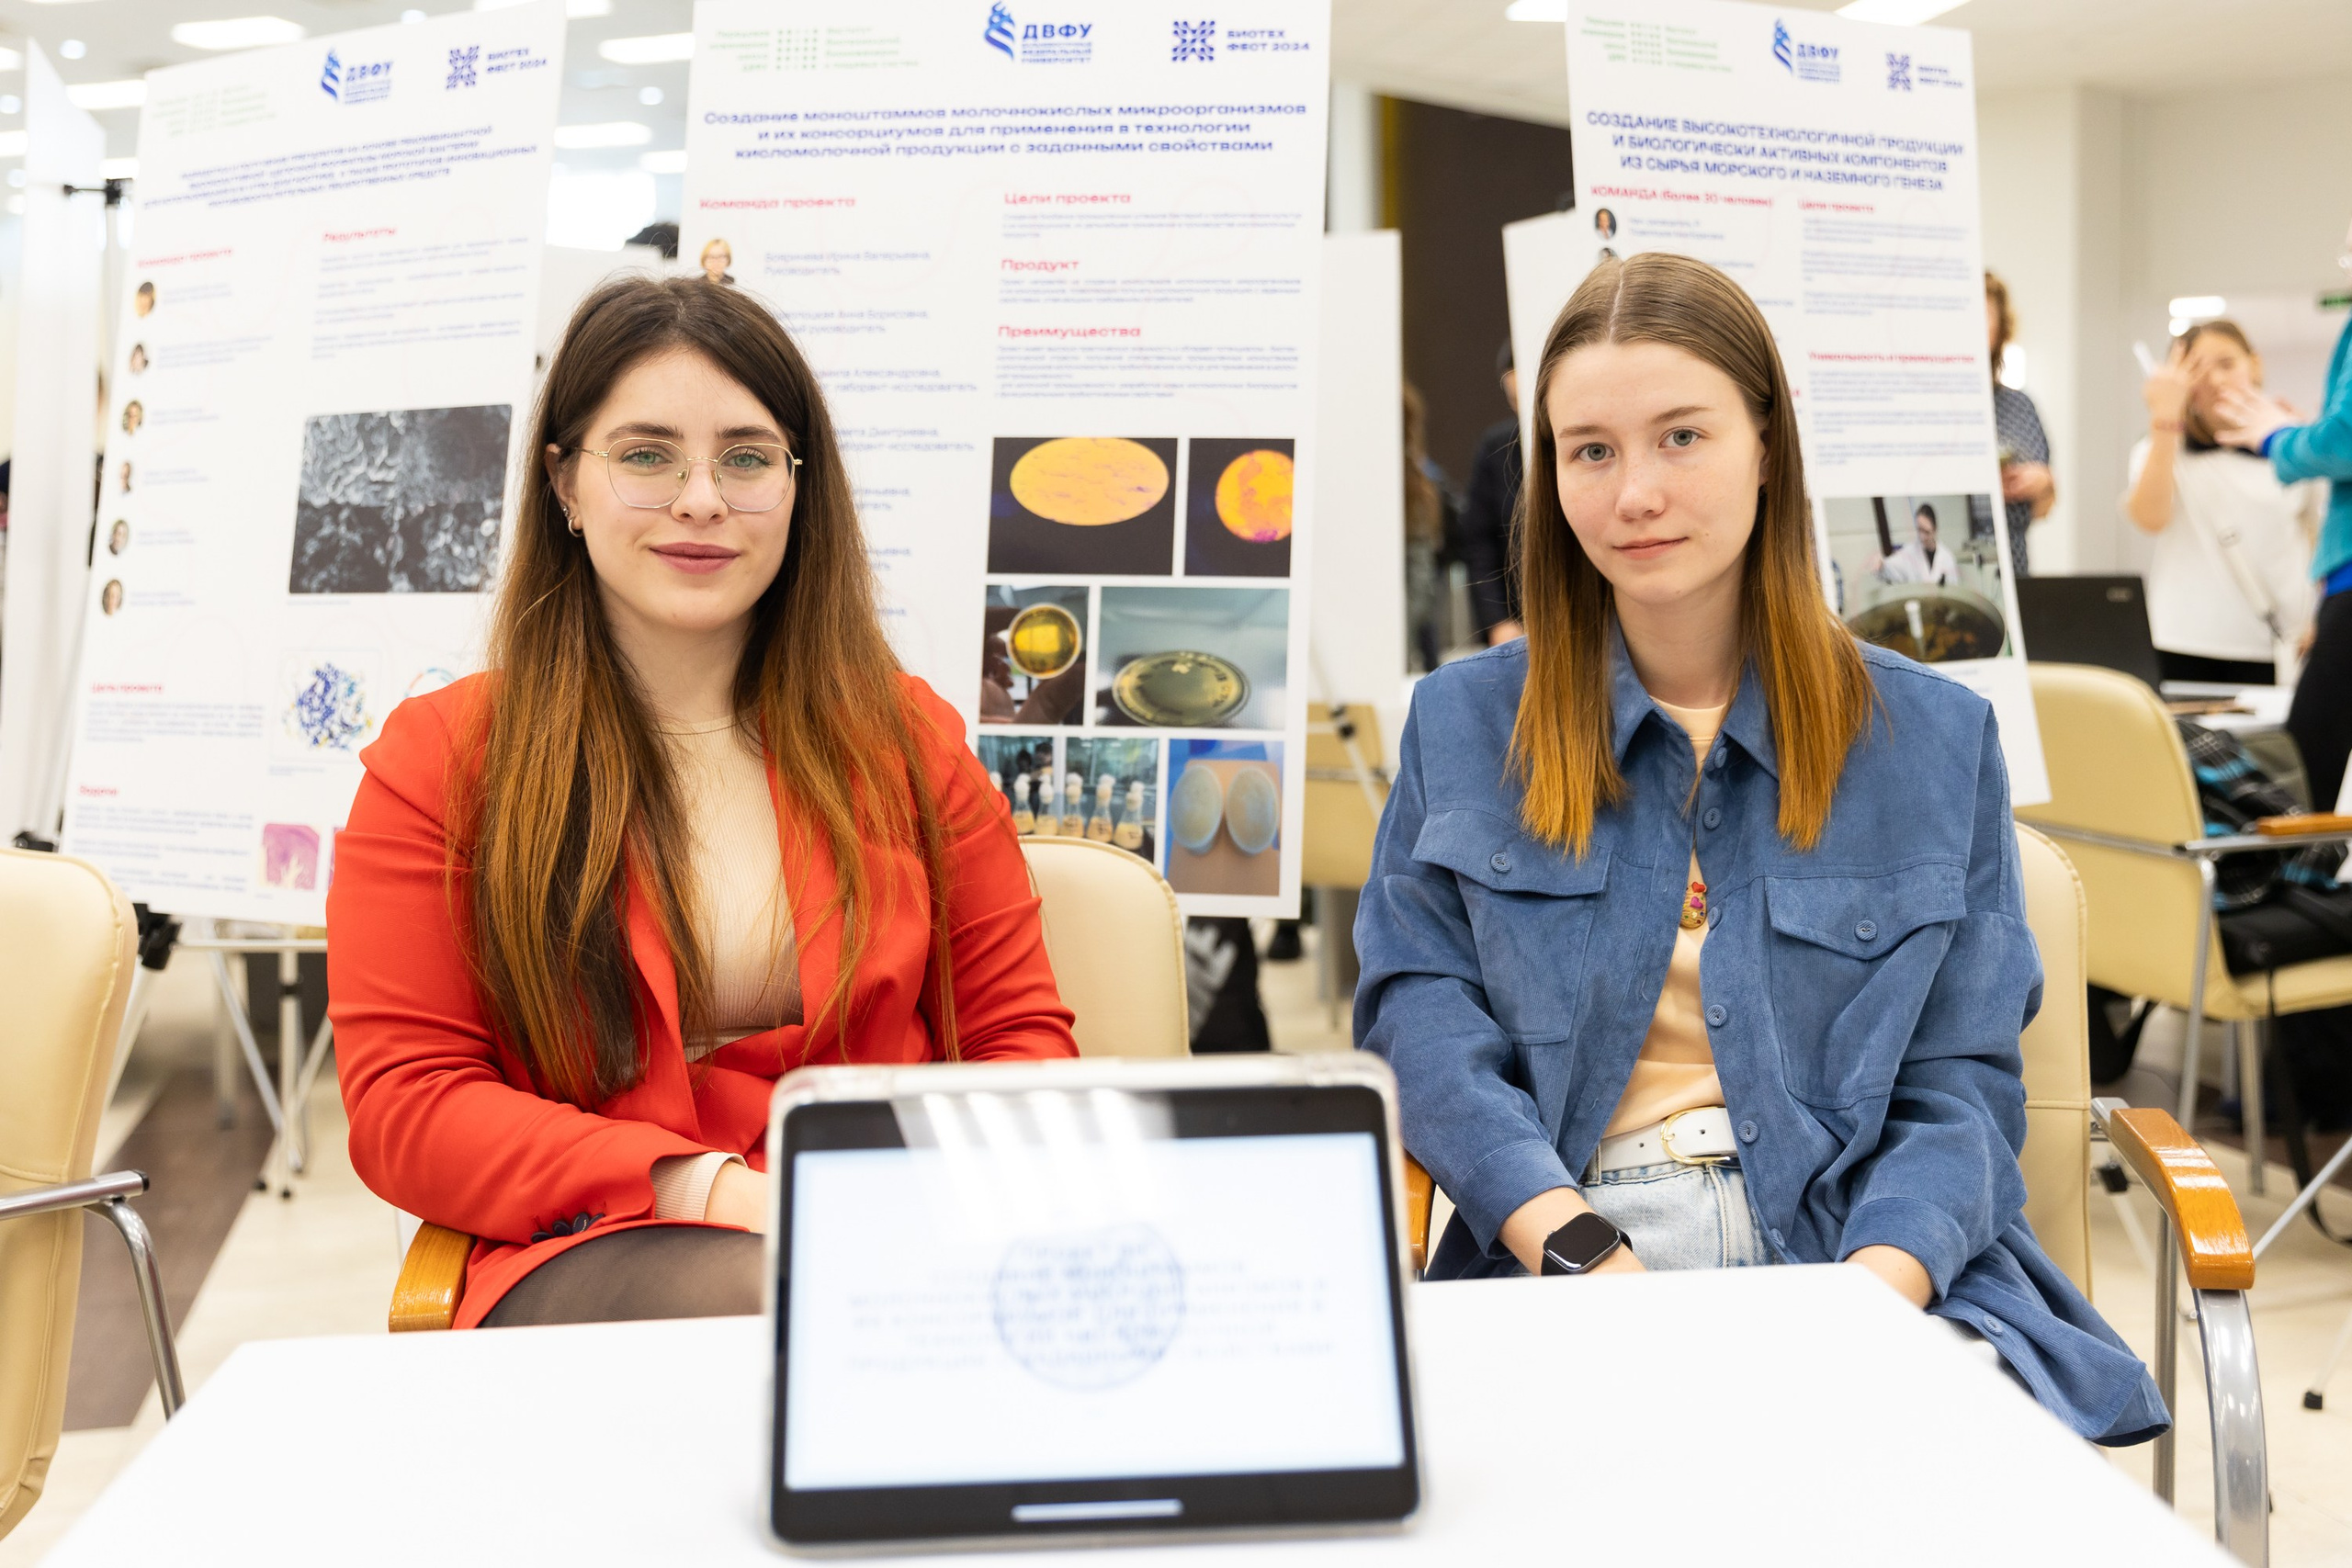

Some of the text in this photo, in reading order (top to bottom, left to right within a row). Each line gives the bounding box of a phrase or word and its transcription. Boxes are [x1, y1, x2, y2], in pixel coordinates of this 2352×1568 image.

[1023, 24, 1091, 39] ДВФУ
[1272, 42, 1309, 51] 2024
[704, 103, 1306, 125] Создание моноштаммов молочнокислых микроорганизмов
[758, 121, 1250, 142] и их консорциумов для применения в технологии
[1587, 111, 1965, 156] СОЗДАНИЕ ВЫСОКОТЕХНОЛОГИЧНОЙ ПРОДУКЦИИ
[735, 138, 1273, 159] кисломолочной продукции с заданными свойствами
[1612, 134, 1949, 173] И БИОЛОГИЧЕСКИ АКТИВНЫХ КОМПОНЕНТОВ
[1620, 155, 1944, 191] ИЗ СЫРЬЯ МОРСКОГО И НАЗЕМНОГО ГЕНЕЗА
[1004, 192, 1131, 206] Цели проекта
[1590, 185, 1657, 200] КОМАНДА
[700, 197, 856, 210] Команда проекта
[1001, 258, 1080, 272] Продукт
[998, 325, 1141, 340] Преимущества
